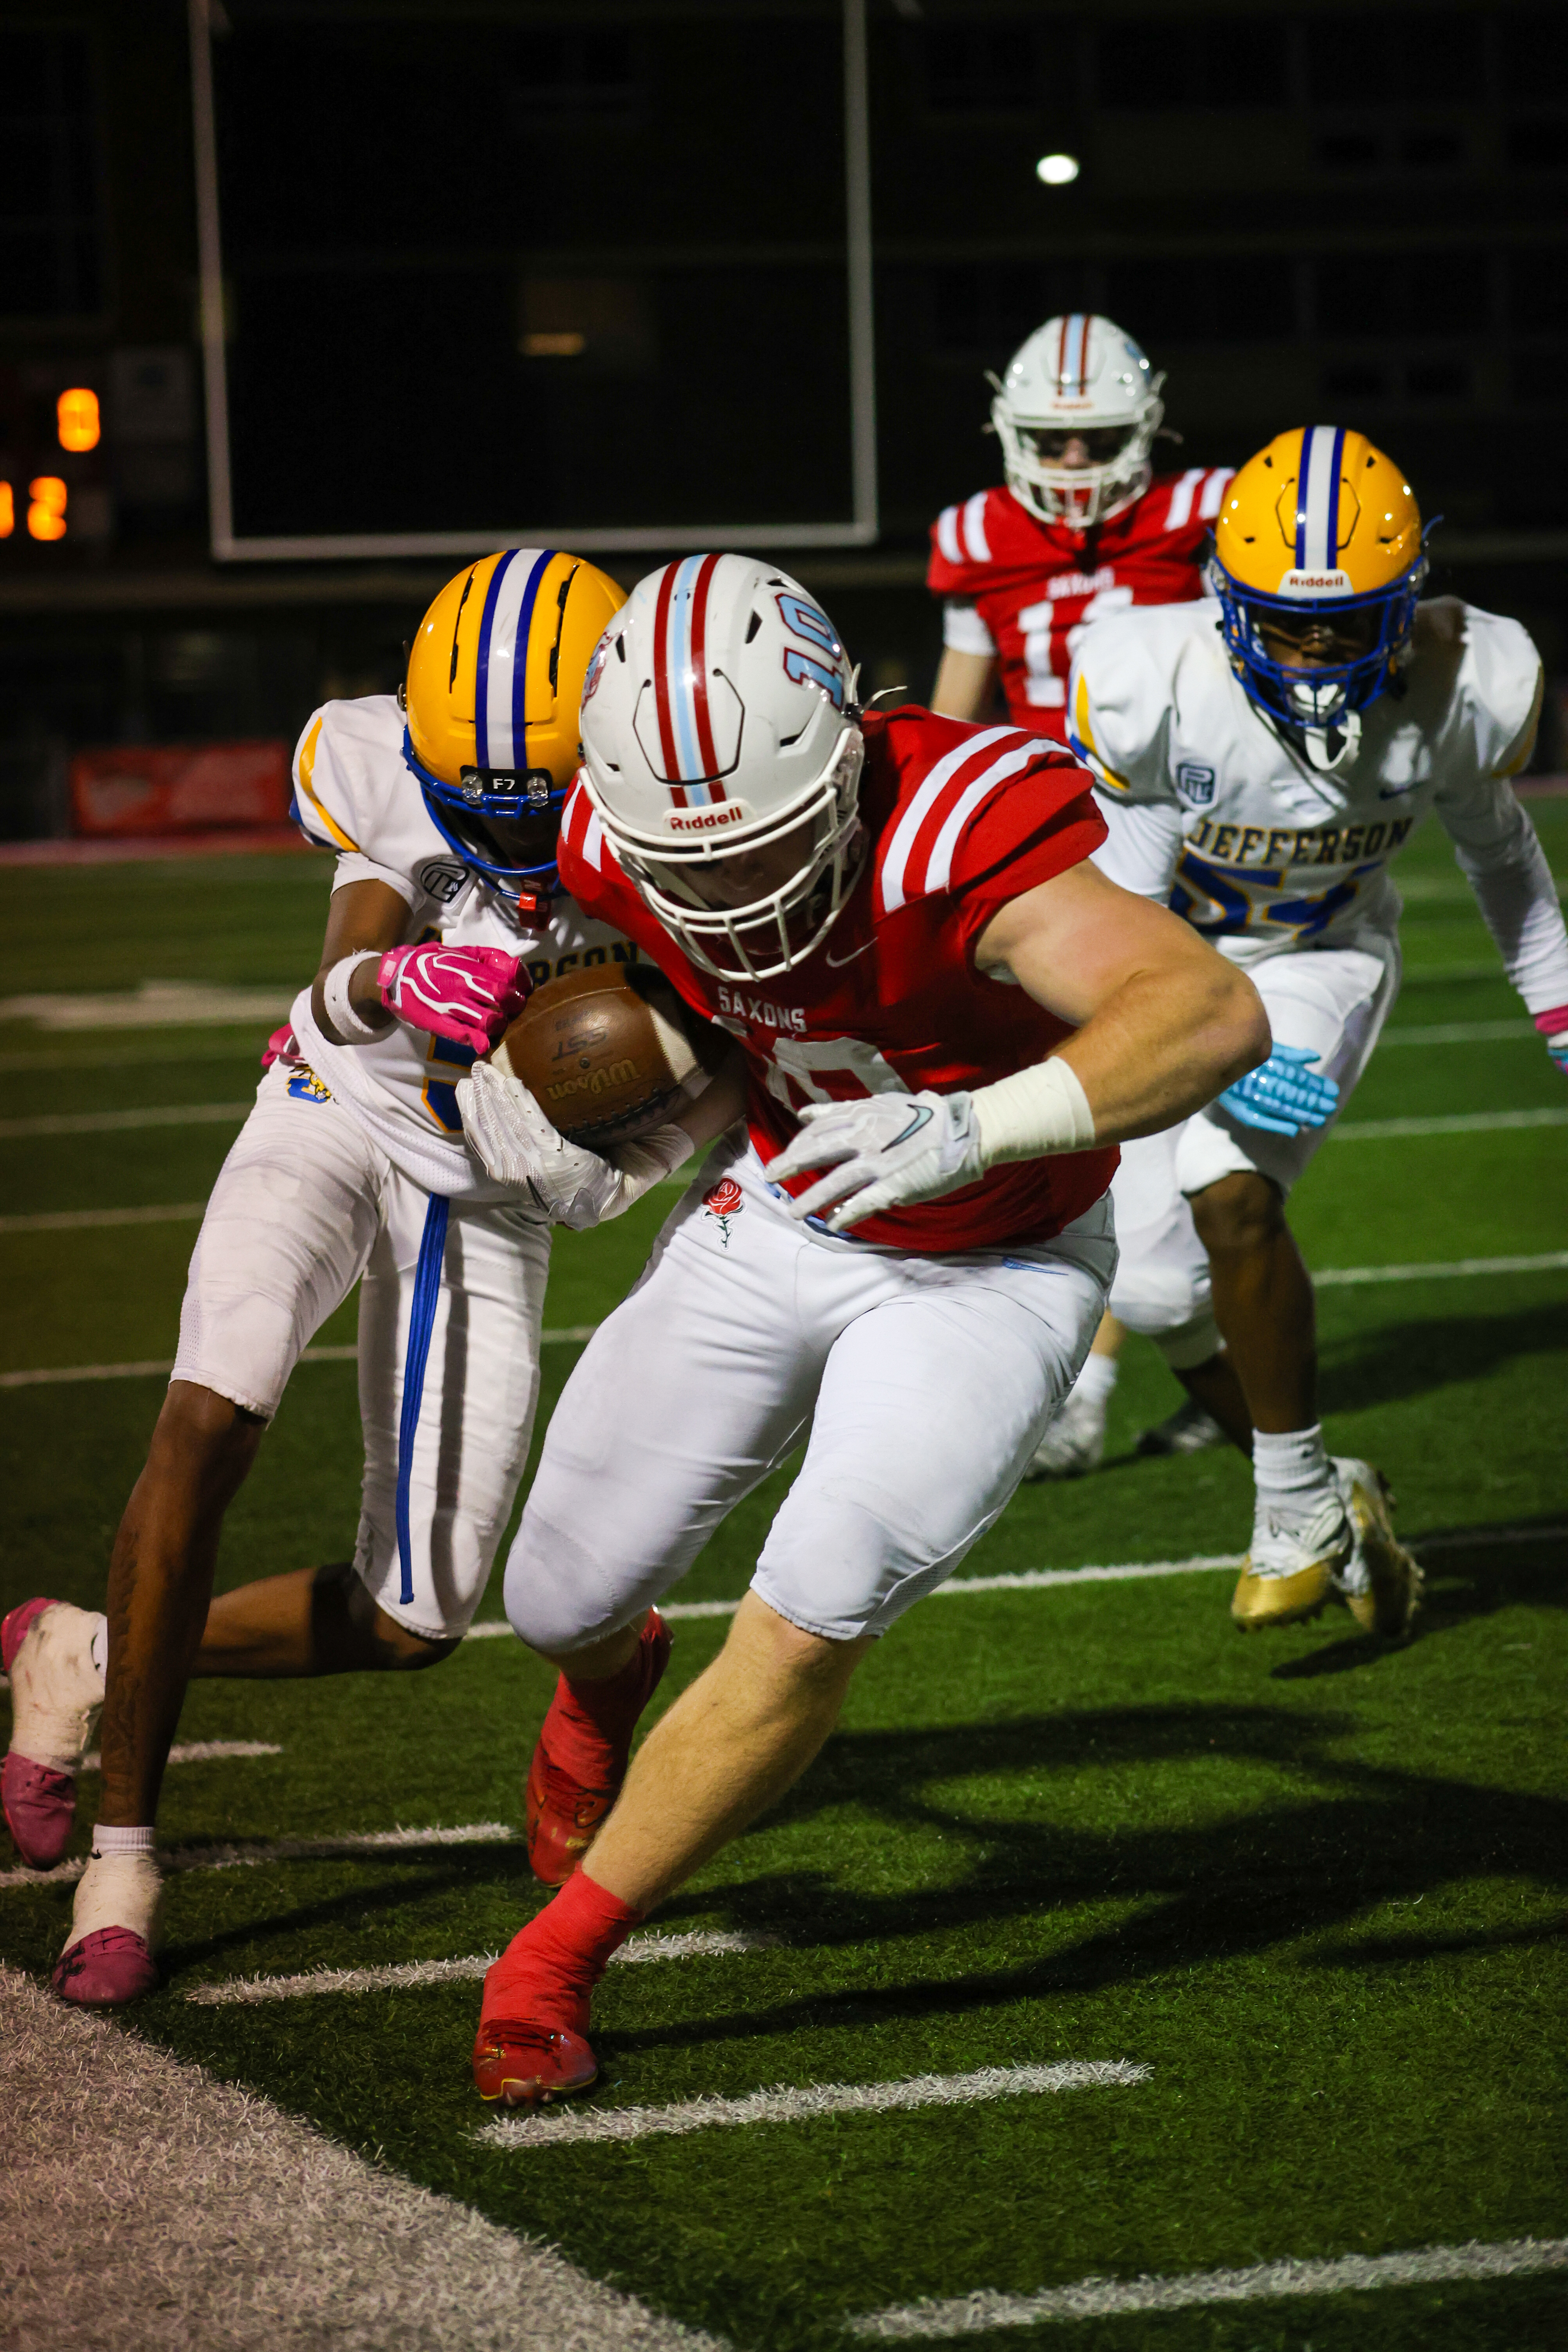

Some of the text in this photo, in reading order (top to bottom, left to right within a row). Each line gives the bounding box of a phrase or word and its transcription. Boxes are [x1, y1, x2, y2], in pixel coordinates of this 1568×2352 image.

[1290, 576, 1343, 586] Riddell
[774, 593, 843, 712] 10
[493, 778, 515, 790] F7
[670, 806, 742, 830] Riddell
[1187, 817, 1414, 864] JEFFERSON
[717, 985, 808, 1033] SAXONS
[546, 1058, 641, 1101] Wilson
